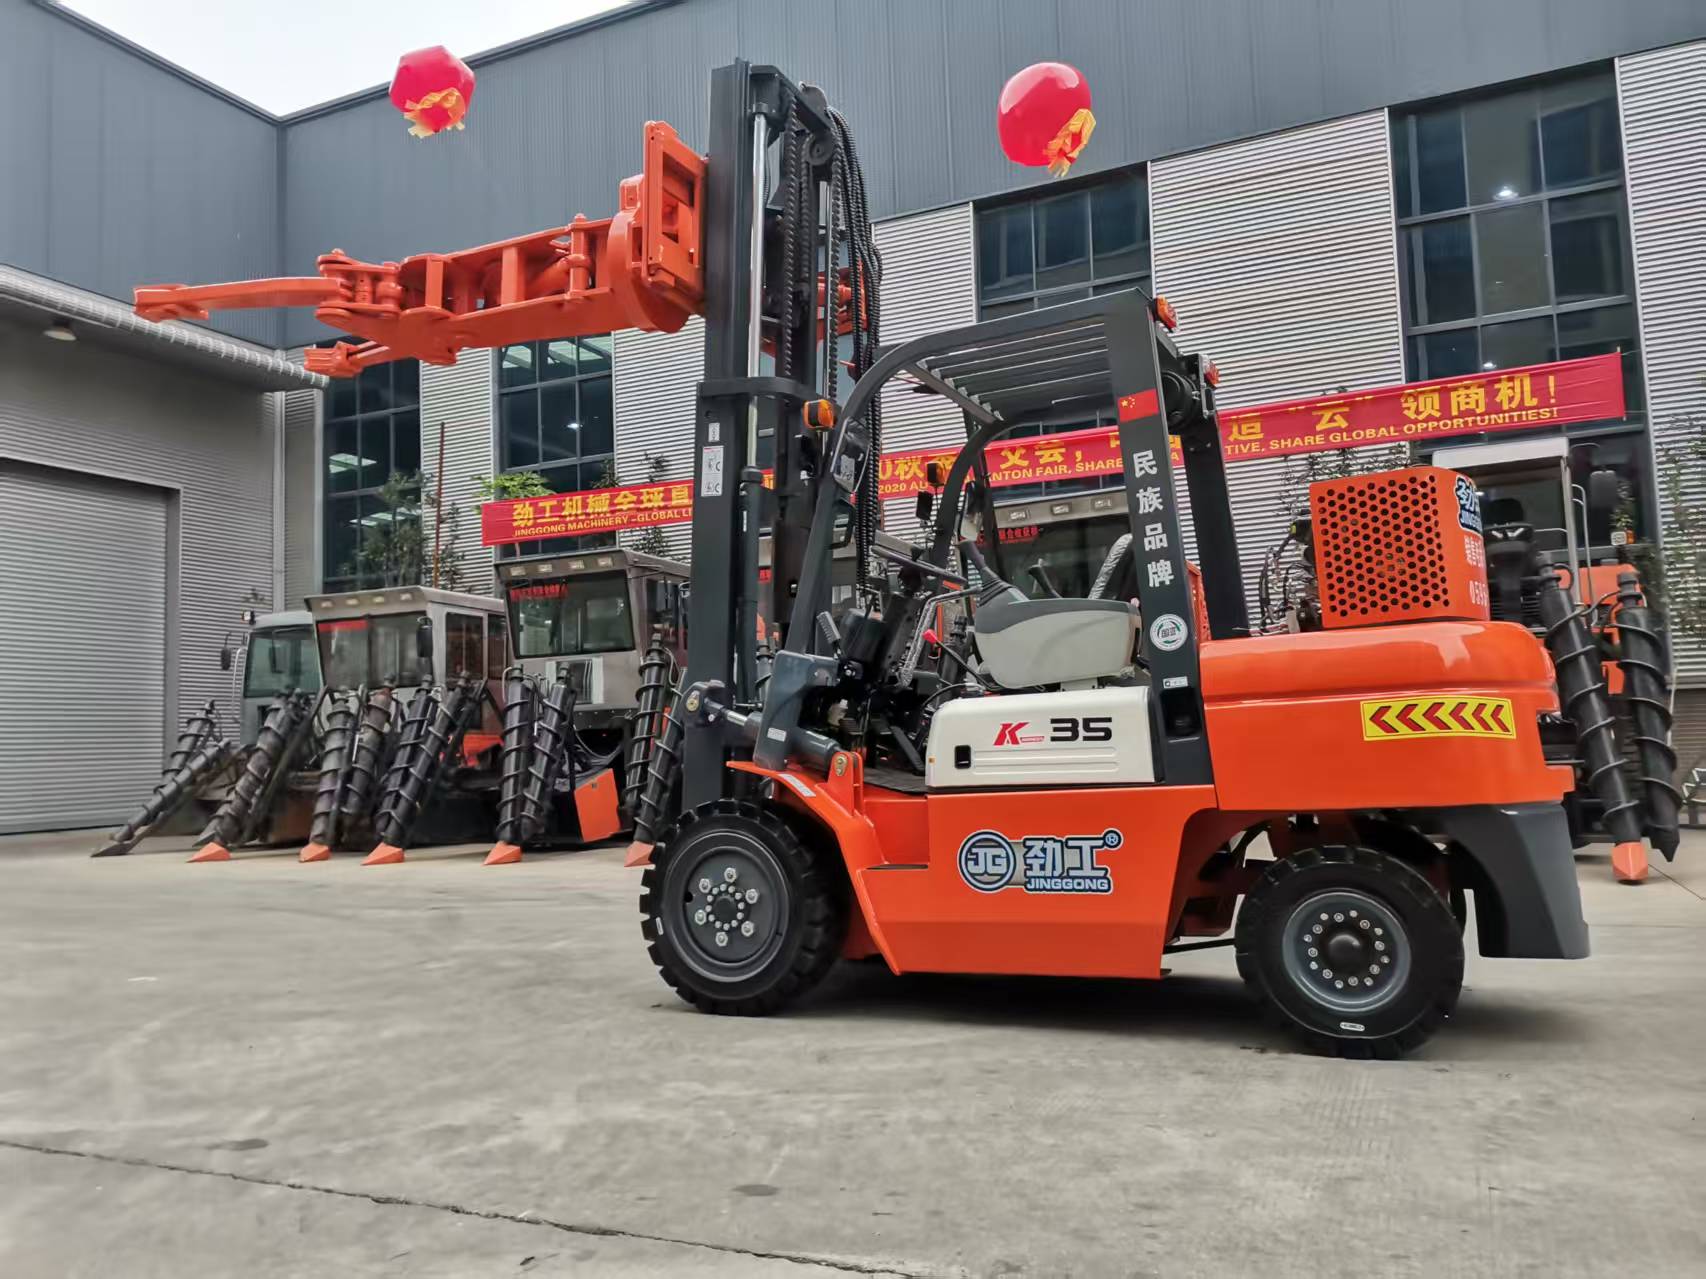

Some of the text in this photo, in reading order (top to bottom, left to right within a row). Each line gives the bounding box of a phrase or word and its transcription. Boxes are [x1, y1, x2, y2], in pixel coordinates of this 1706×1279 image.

[514, 524, 566, 537] JINGGONG
[567, 516, 628, 531] MACHINERY
[1075, 458, 1123, 472] SHARE
[1269, 434, 1325, 450] SHARE
[1329, 426, 1398, 443] GLOBAL
[1403, 407, 1558, 434] OPPORTUNITIES!
[1132, 449, 1175, 588] 民族品牌
[993, 717, 1113, 746] K 35
[1024, 839, 1108, 877] 劲工
[1026, 877, 1109, 890] JINGGONG
